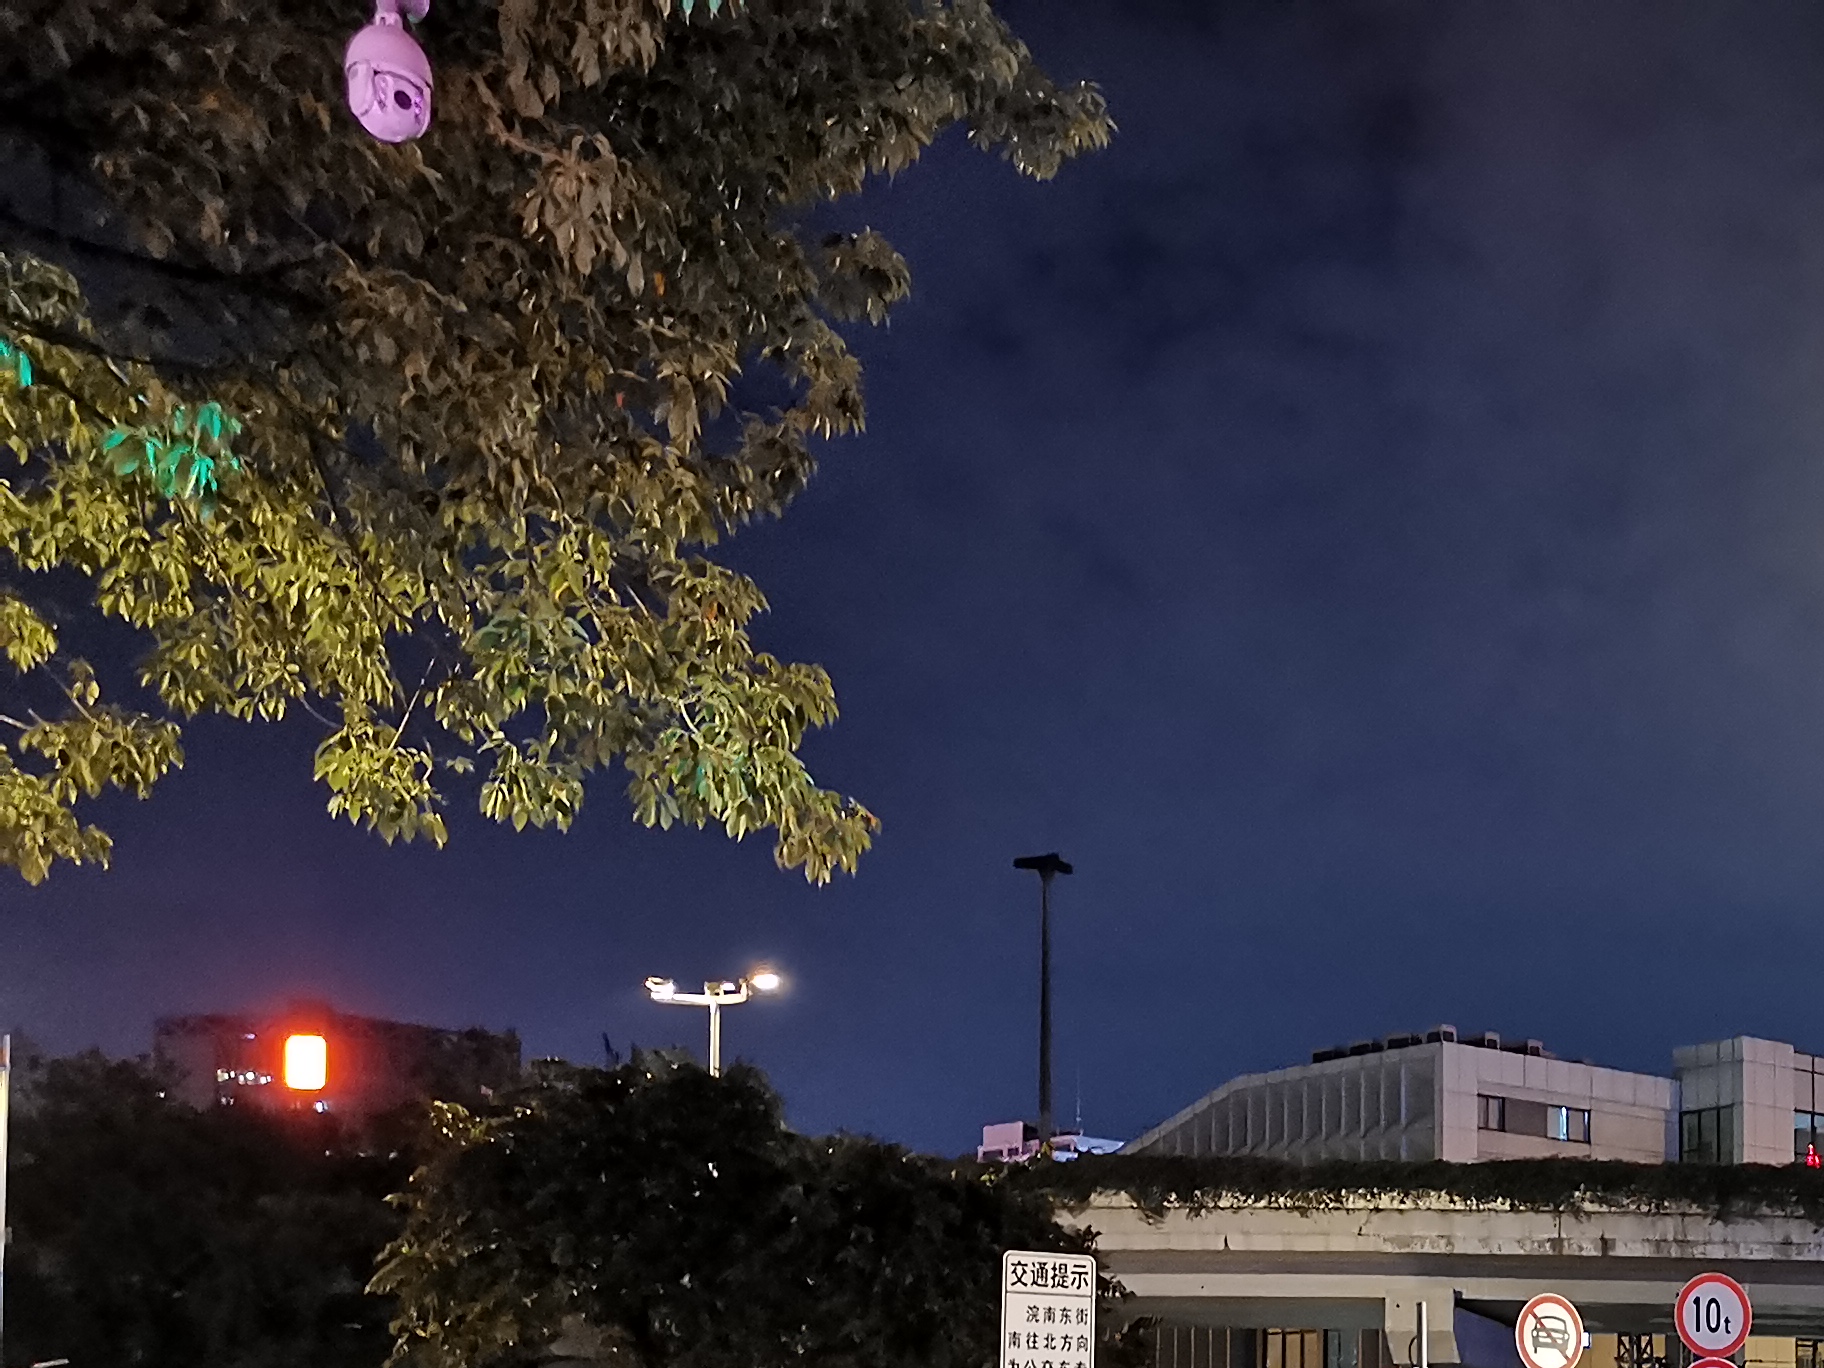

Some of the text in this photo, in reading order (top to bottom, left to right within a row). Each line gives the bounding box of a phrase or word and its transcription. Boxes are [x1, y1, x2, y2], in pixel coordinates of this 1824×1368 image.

[1010, 1260, 1089, 1290] 交通提示
[1008, 1331, 1088, 1352] 南往北方向
